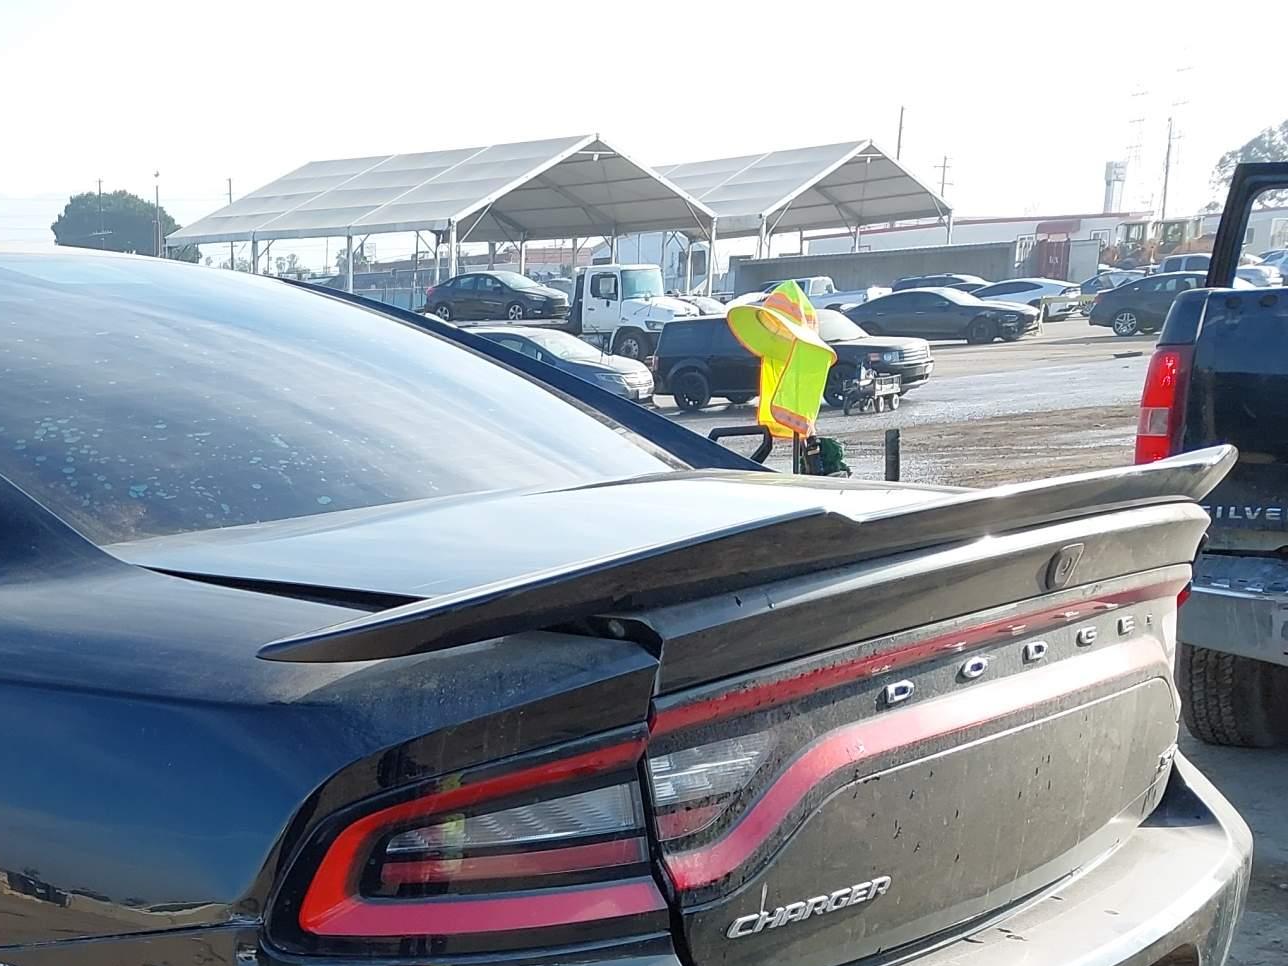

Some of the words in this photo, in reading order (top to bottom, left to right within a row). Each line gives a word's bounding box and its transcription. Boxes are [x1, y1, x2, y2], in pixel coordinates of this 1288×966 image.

[1201, 505, 1288, 521] ILVE
[884, 614, 1135, 705] DODGE
[726, 874, 893, 940] CHARGER
